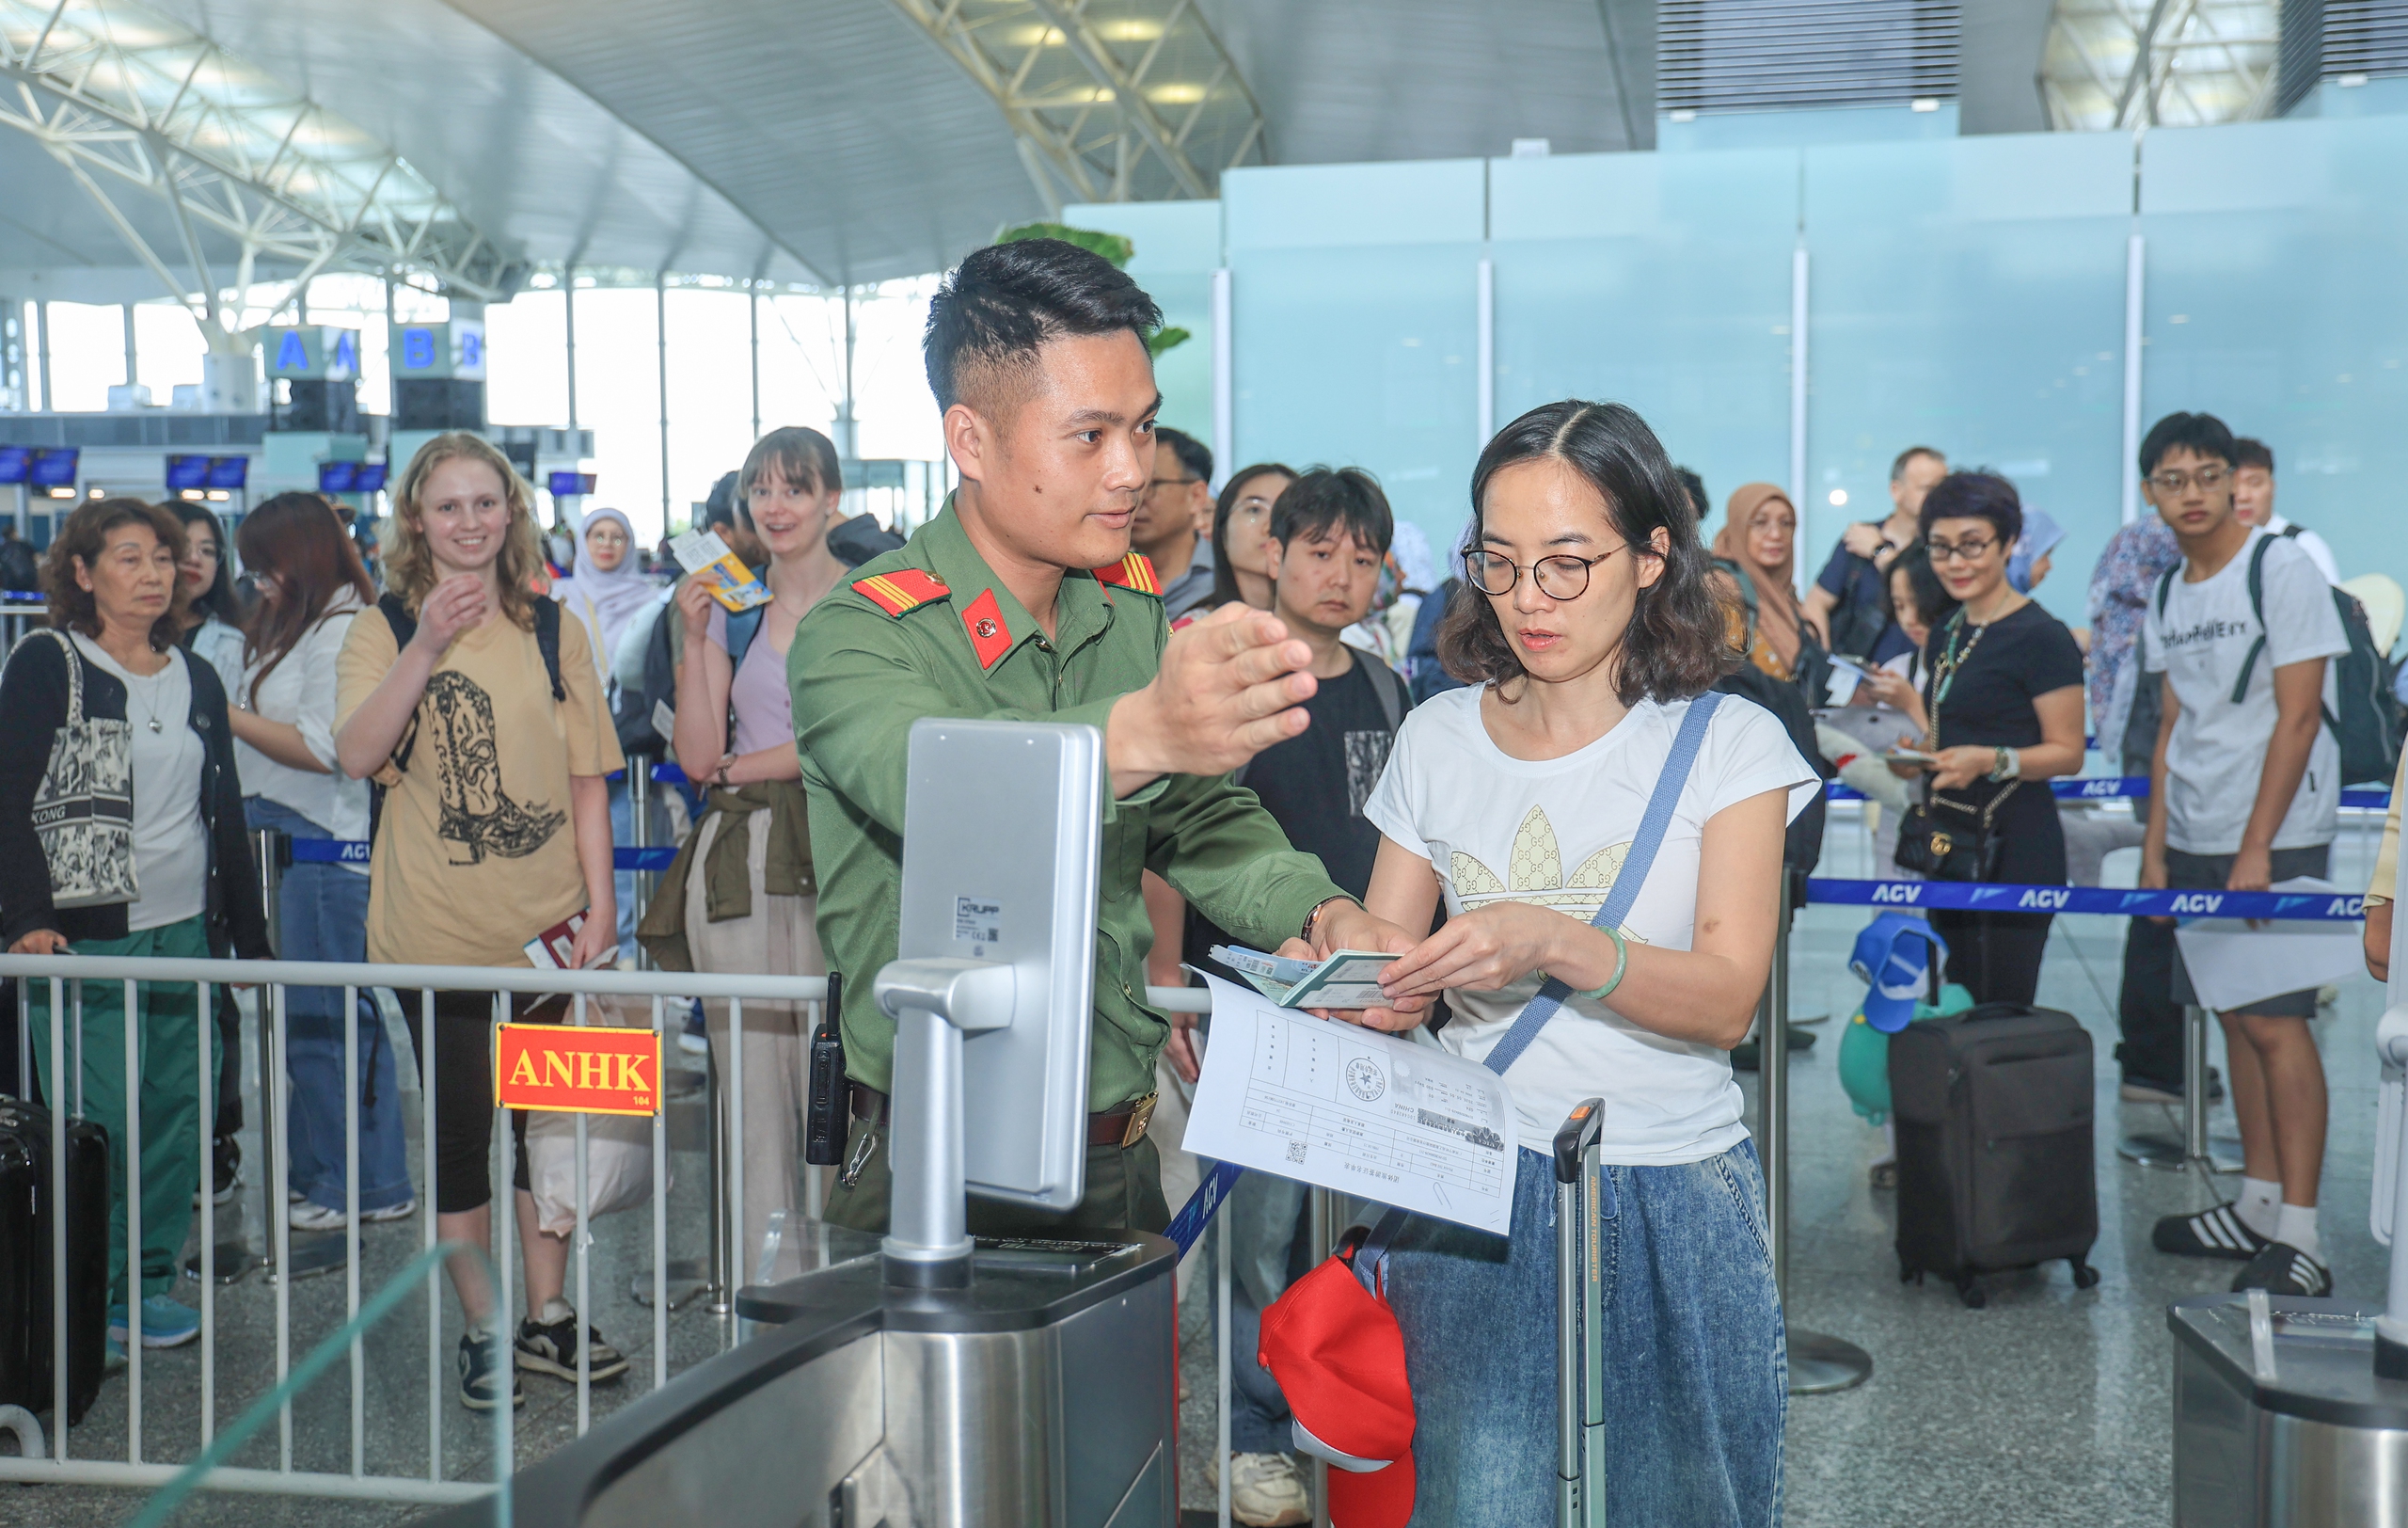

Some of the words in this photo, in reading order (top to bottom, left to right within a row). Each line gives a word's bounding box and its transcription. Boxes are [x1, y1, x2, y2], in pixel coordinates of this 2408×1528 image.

[277, 330, 309, 371] A
[337, 332, 357, 372] A
[404, 328, 436, 369] B
[1871, 883, 1923, 903] ACV
[2018, 888, 2071, 908] ACV
[2170, 894, 2224, 913] ACV
[2326, 897, 2364, 916] AC
[509, 1048, 651, 1091] ANHK
[633, 1095, 650, 1106] 104
[1393, 1102, 1414, 1112] CHINA
[1202, 1172, 1219, 1219] ACV
